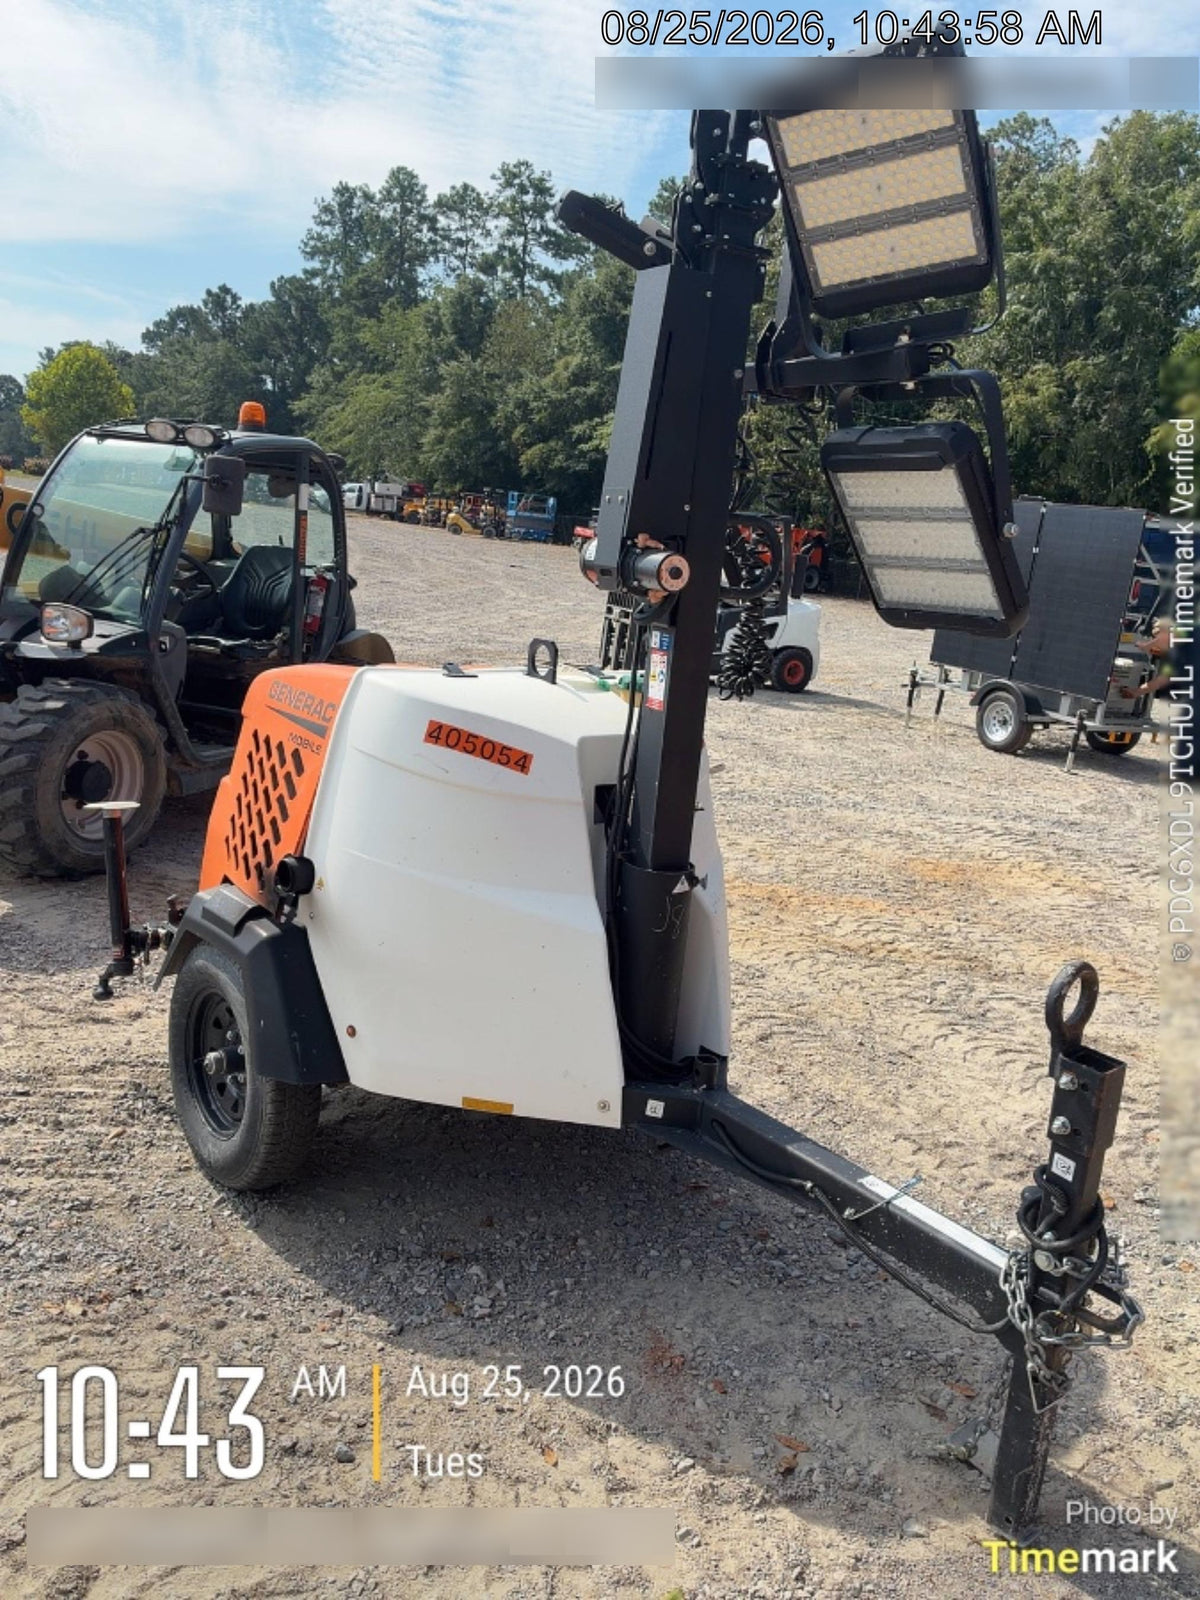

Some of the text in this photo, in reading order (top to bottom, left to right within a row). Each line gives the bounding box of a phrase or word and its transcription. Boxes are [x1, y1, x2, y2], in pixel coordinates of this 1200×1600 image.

[268, 680, 337, 722] GENERAC
[288, 732, 323, 756] MOBILE
[428, 725, 529, 772] 405054
